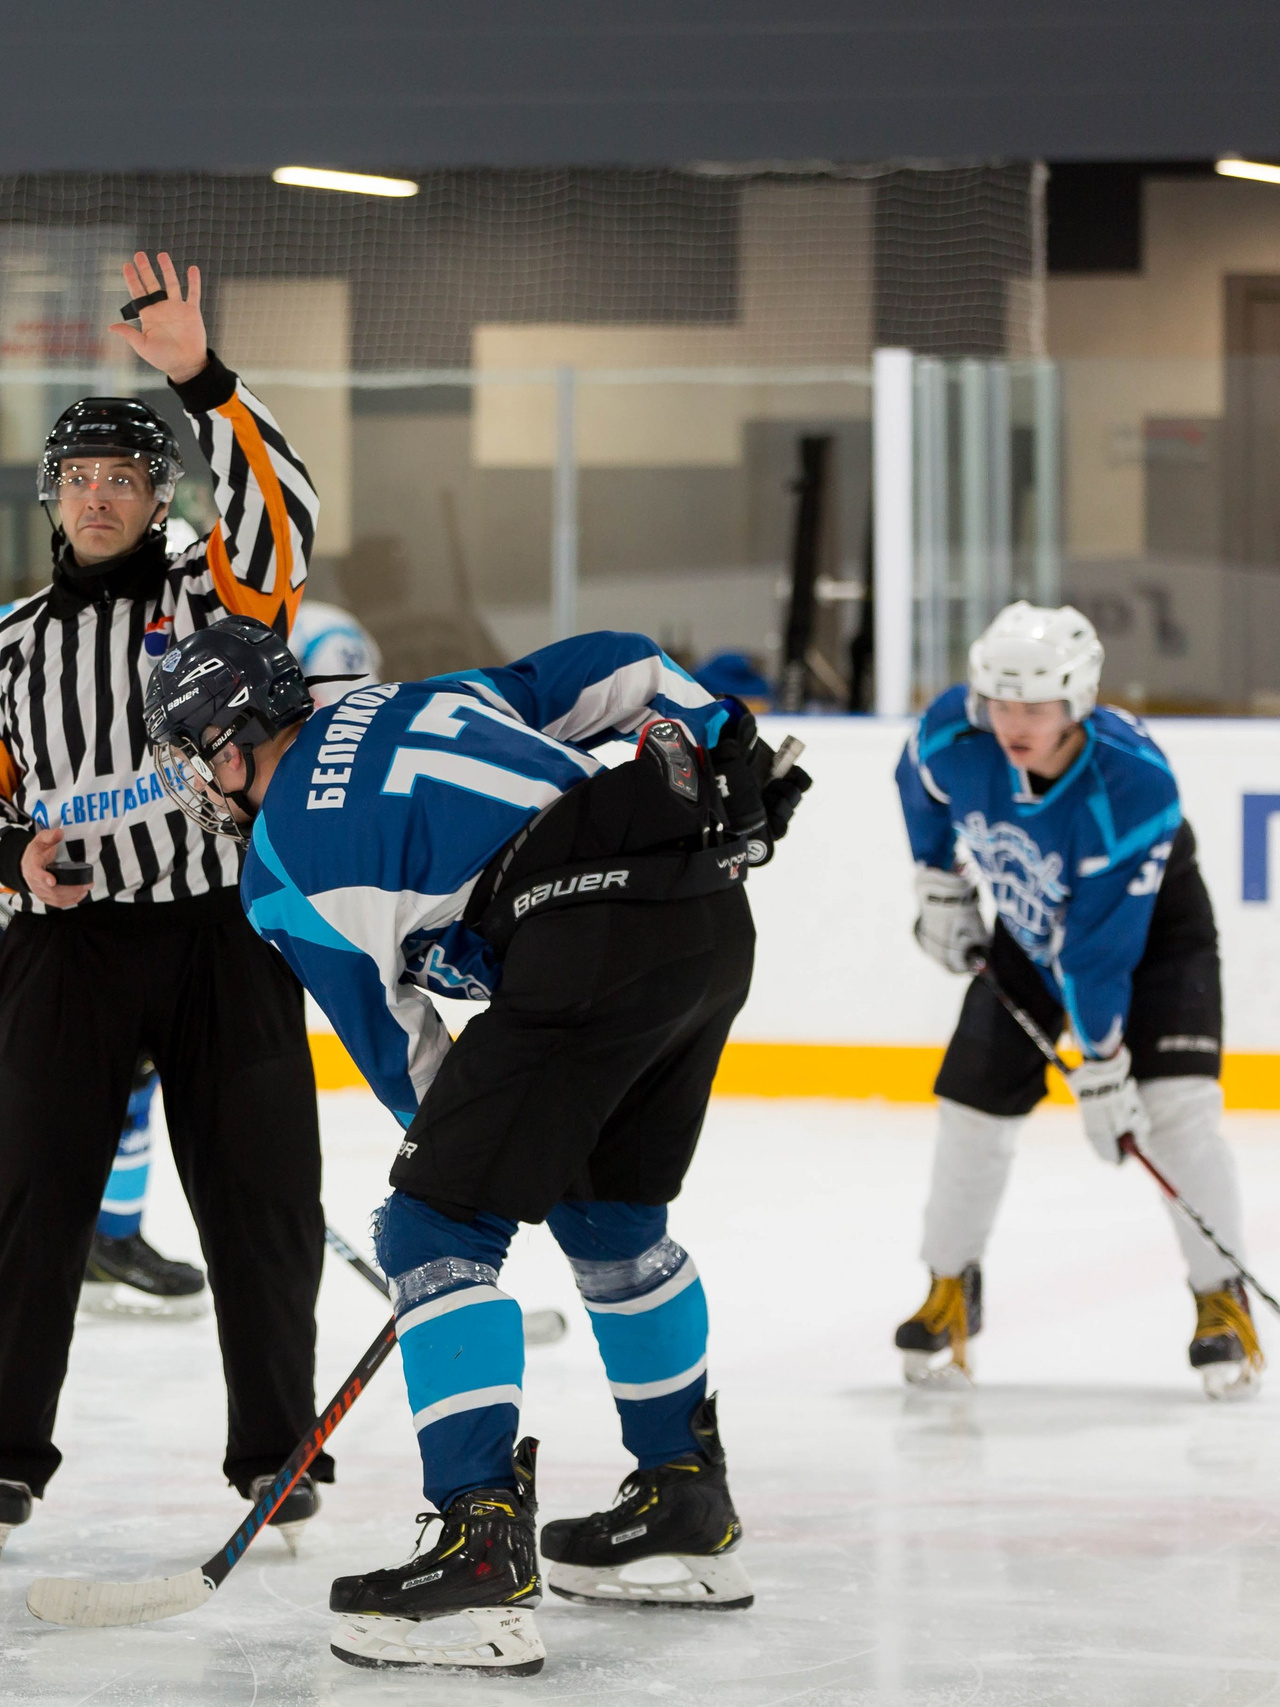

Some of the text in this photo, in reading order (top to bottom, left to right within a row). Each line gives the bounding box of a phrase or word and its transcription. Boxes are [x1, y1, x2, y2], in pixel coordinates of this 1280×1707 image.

[167, 687, 200, 711] BAUER
[379, 692, 604, 811] 17
[513, 870, 630, 919] BAUER
